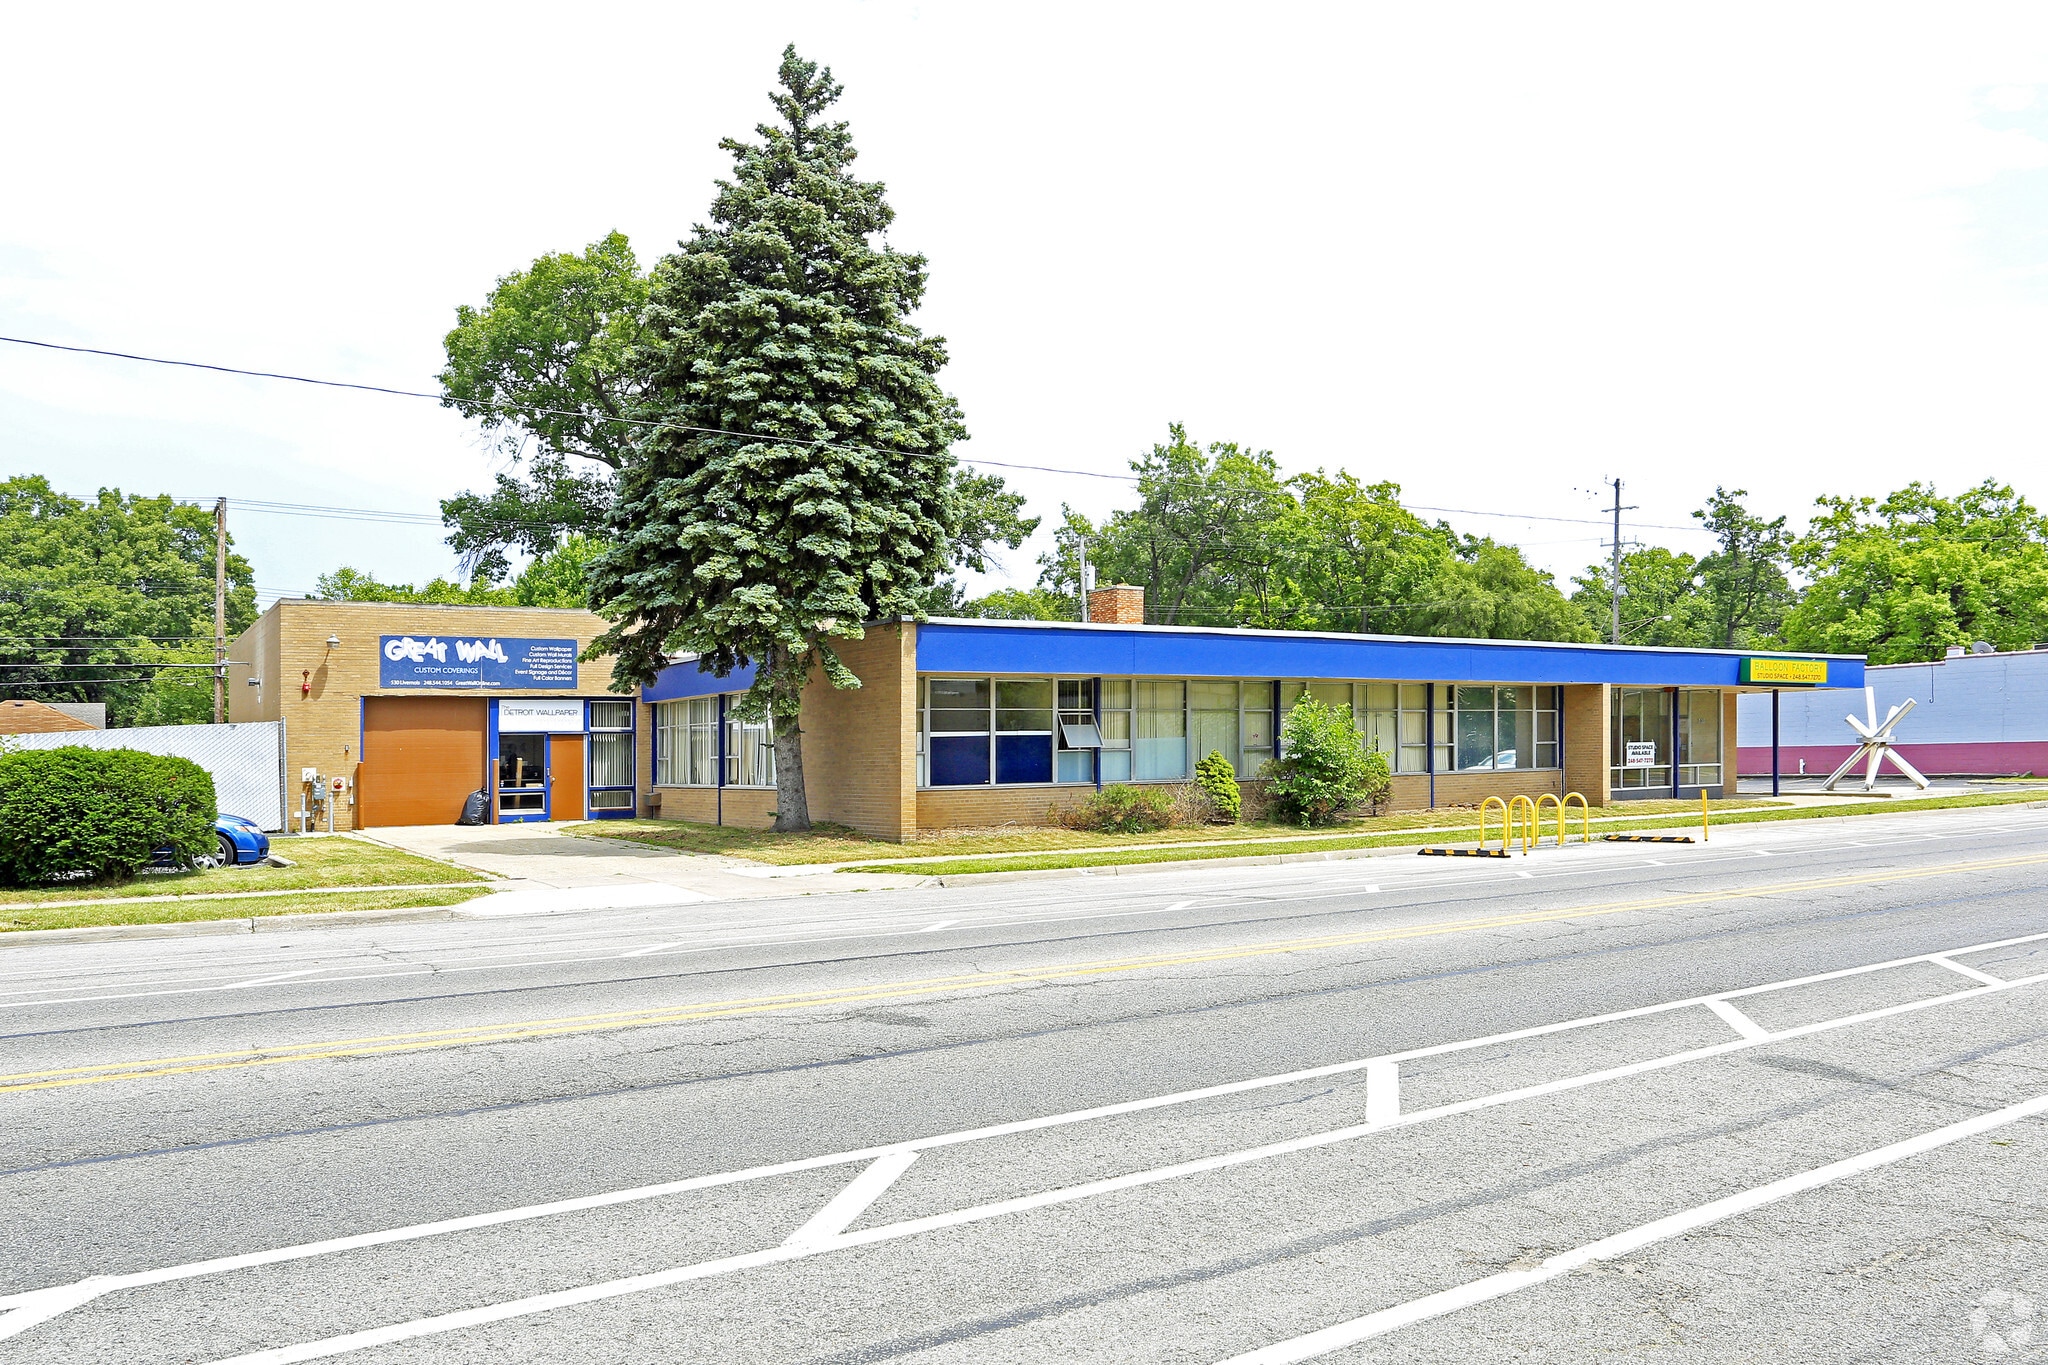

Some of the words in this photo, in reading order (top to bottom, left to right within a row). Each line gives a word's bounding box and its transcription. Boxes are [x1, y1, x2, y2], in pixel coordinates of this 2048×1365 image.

[384, 637, 448, 663] GREAT
[455, 638, 509, 663] WALL
[1754, 662, 1788, 672] BALLOON
[1792, 663, 1823, 673] FACTORY
